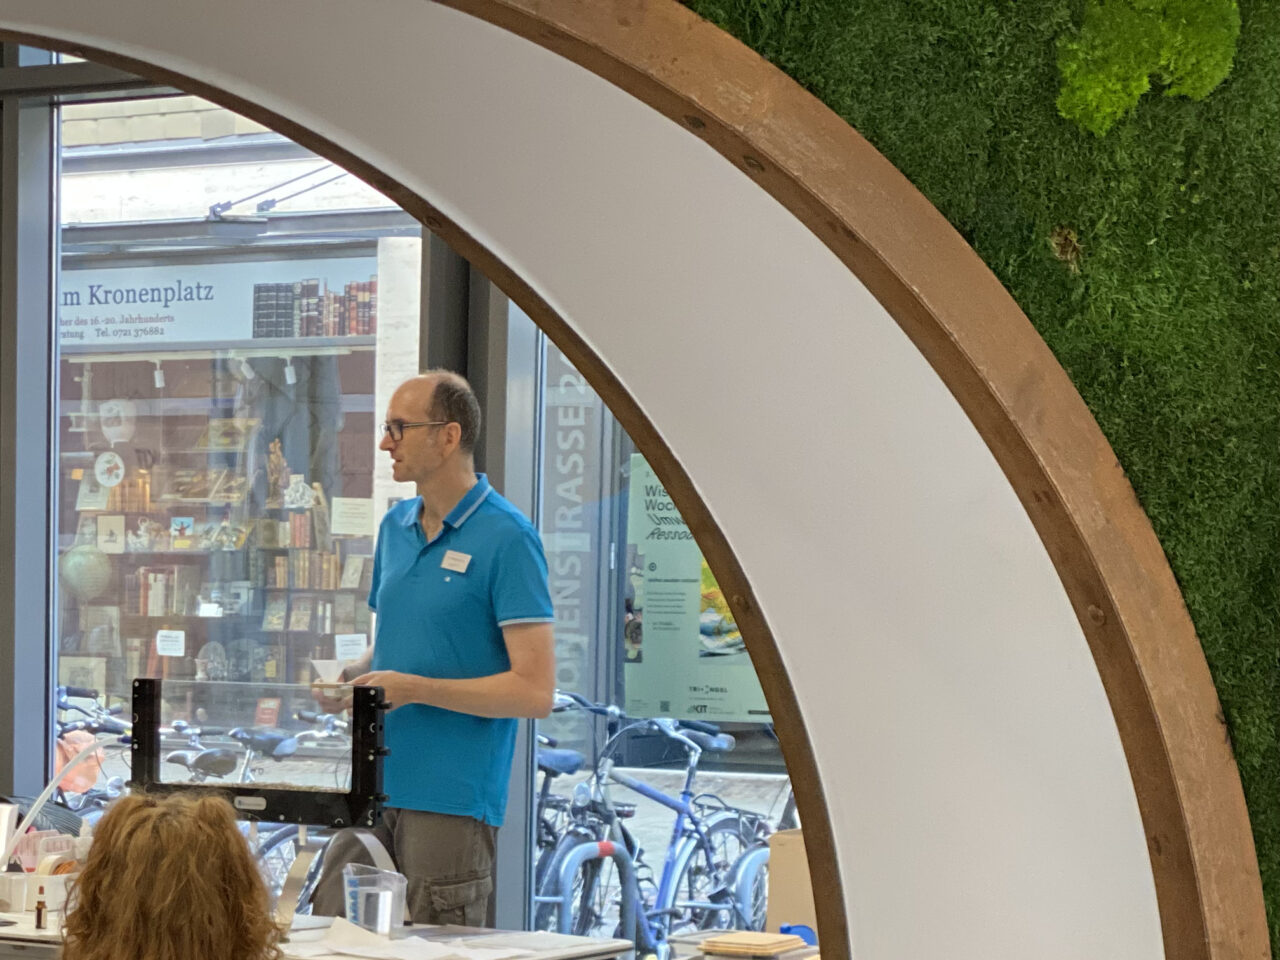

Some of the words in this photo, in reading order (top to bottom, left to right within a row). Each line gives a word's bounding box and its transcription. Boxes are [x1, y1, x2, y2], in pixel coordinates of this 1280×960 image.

[60, 291, 81, 306] m
[88, 279, 215, 309] Kronenplatz
[74, 316, 89, 326] des
[119, 313, 175, 325] Jahrhunderts
[95, 328, 112, 338] Tel.
[112, 329, 132, 339] 0721
[133, 326, 165, 338] 376882
